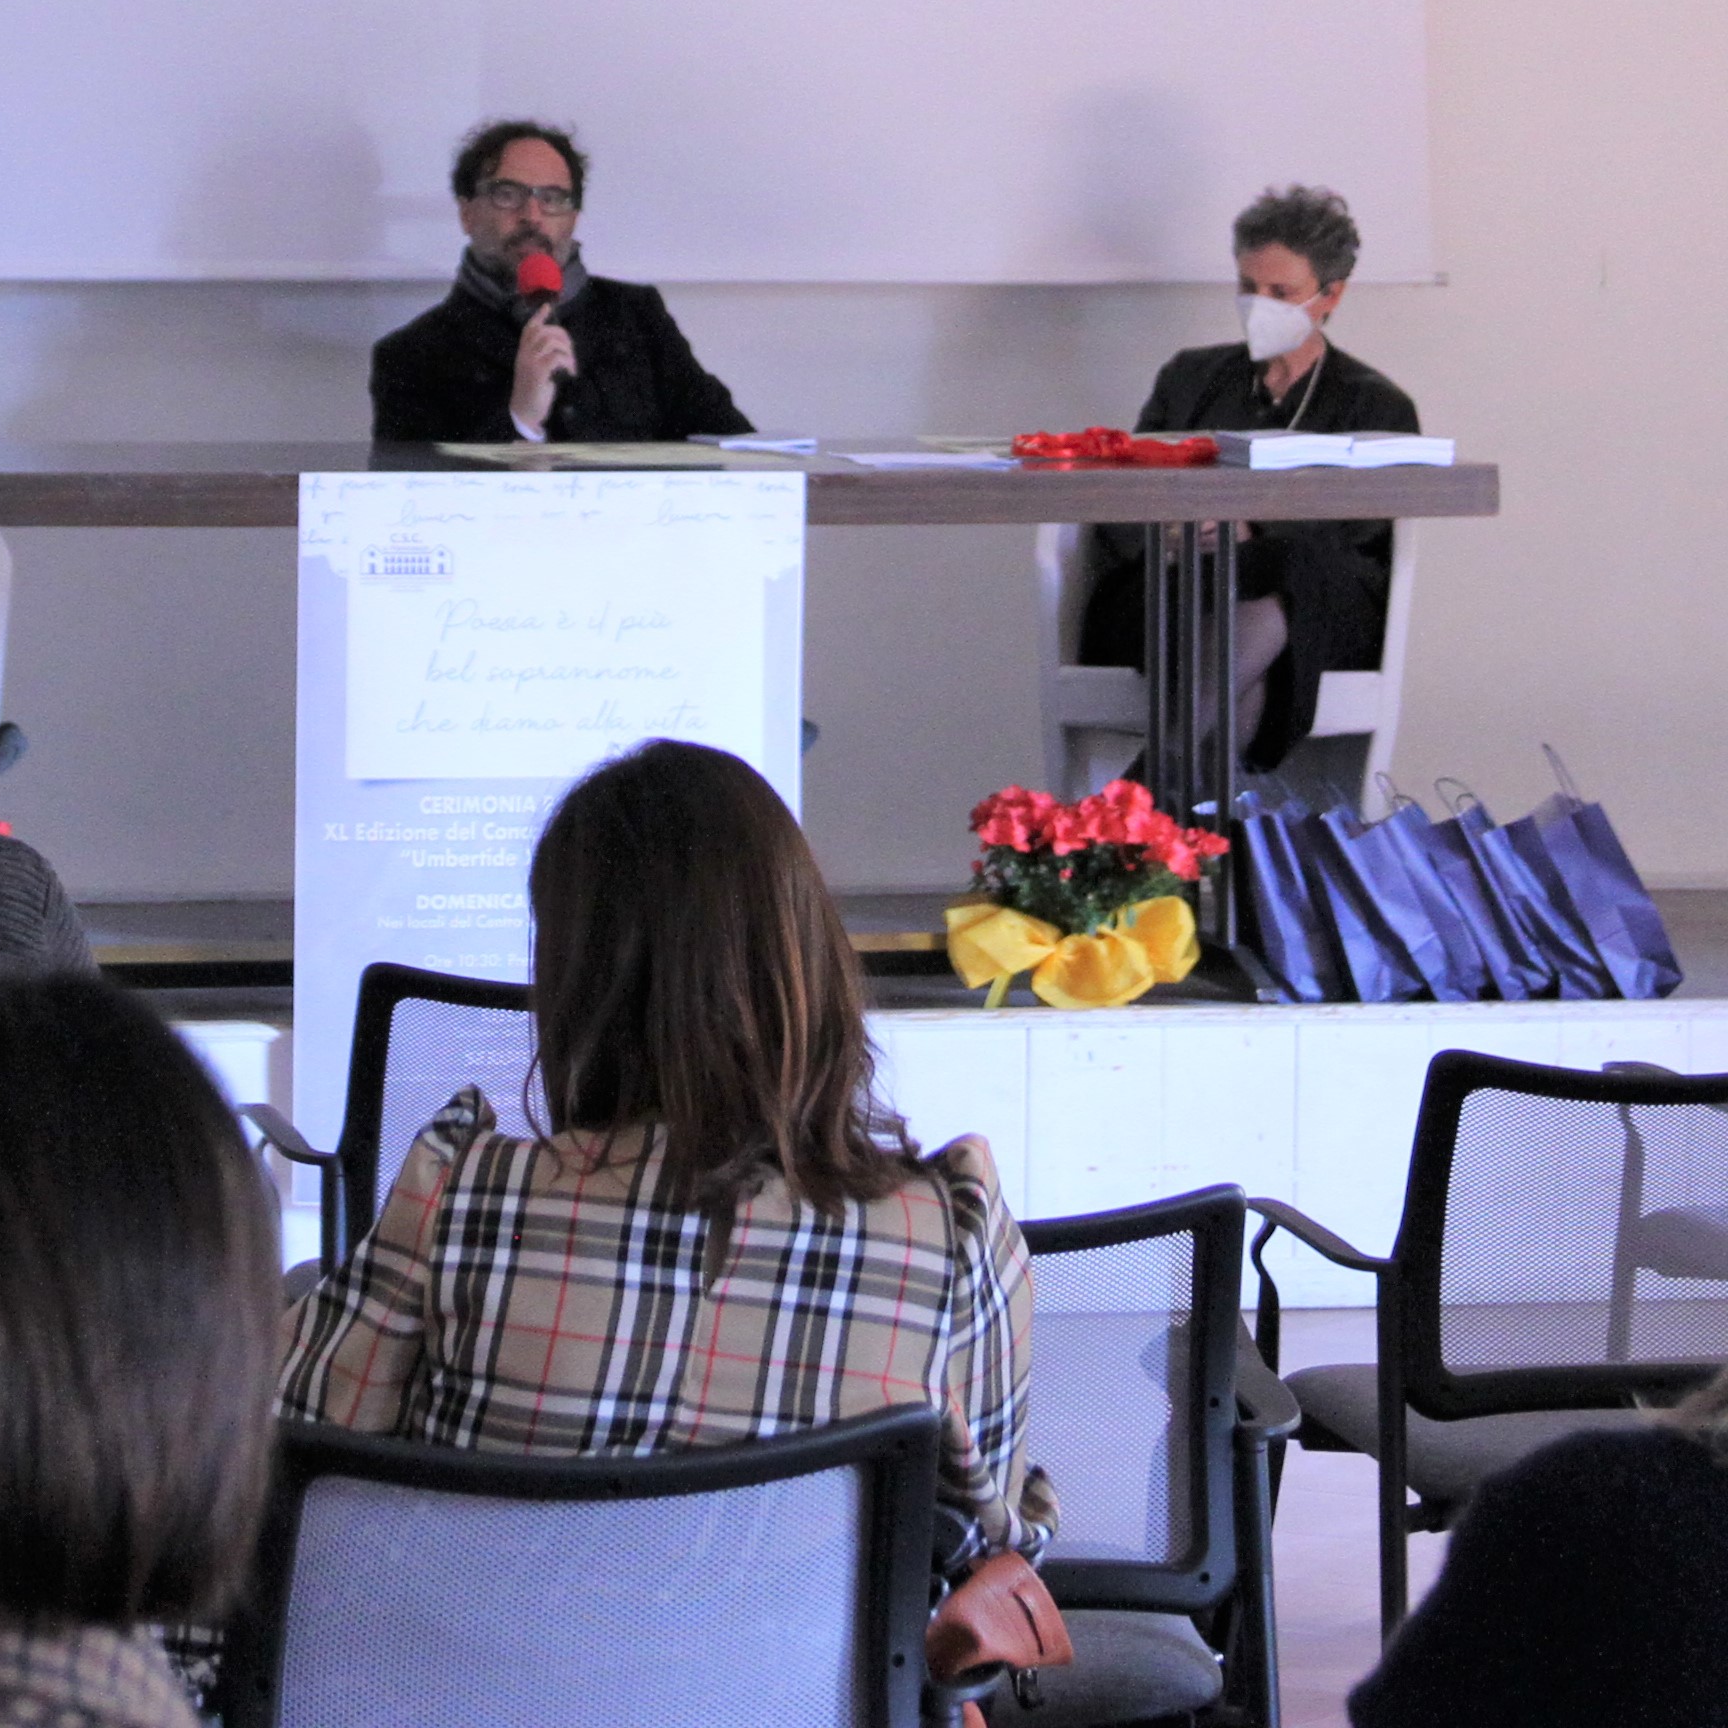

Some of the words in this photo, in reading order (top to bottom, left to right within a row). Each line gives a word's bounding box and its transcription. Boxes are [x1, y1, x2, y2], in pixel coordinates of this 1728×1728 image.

[435, 597, 546, 642] Poesia
[556, 609, 576, 631] è
[587, 600, 612, 634] il
[614, 609, 674, 642] più
[425, 648, 478, 683] bel
[484, 661, 681, 693] soprannome
[395, 699, 459, 734] che
[469, 699, 566, 735] diamo
[574, 698, 630, 734] alla
[643, 697, 706, 735] vita
[418, 794, 537, 815] CERIMONIA
[322, 822, 349, 842] XL
[354, 820, 440, 842] Edizione
[444, 820, 476, 841] del
[482, 821, 533, 841] Conc
[415, 893, 527, 911] DOMENICA
[376, 915, 404, 929] Nei
[407, 913, 446, 929] locali
[448, 914, 472, 929] del
[423, 953, 453, 968] Ore
